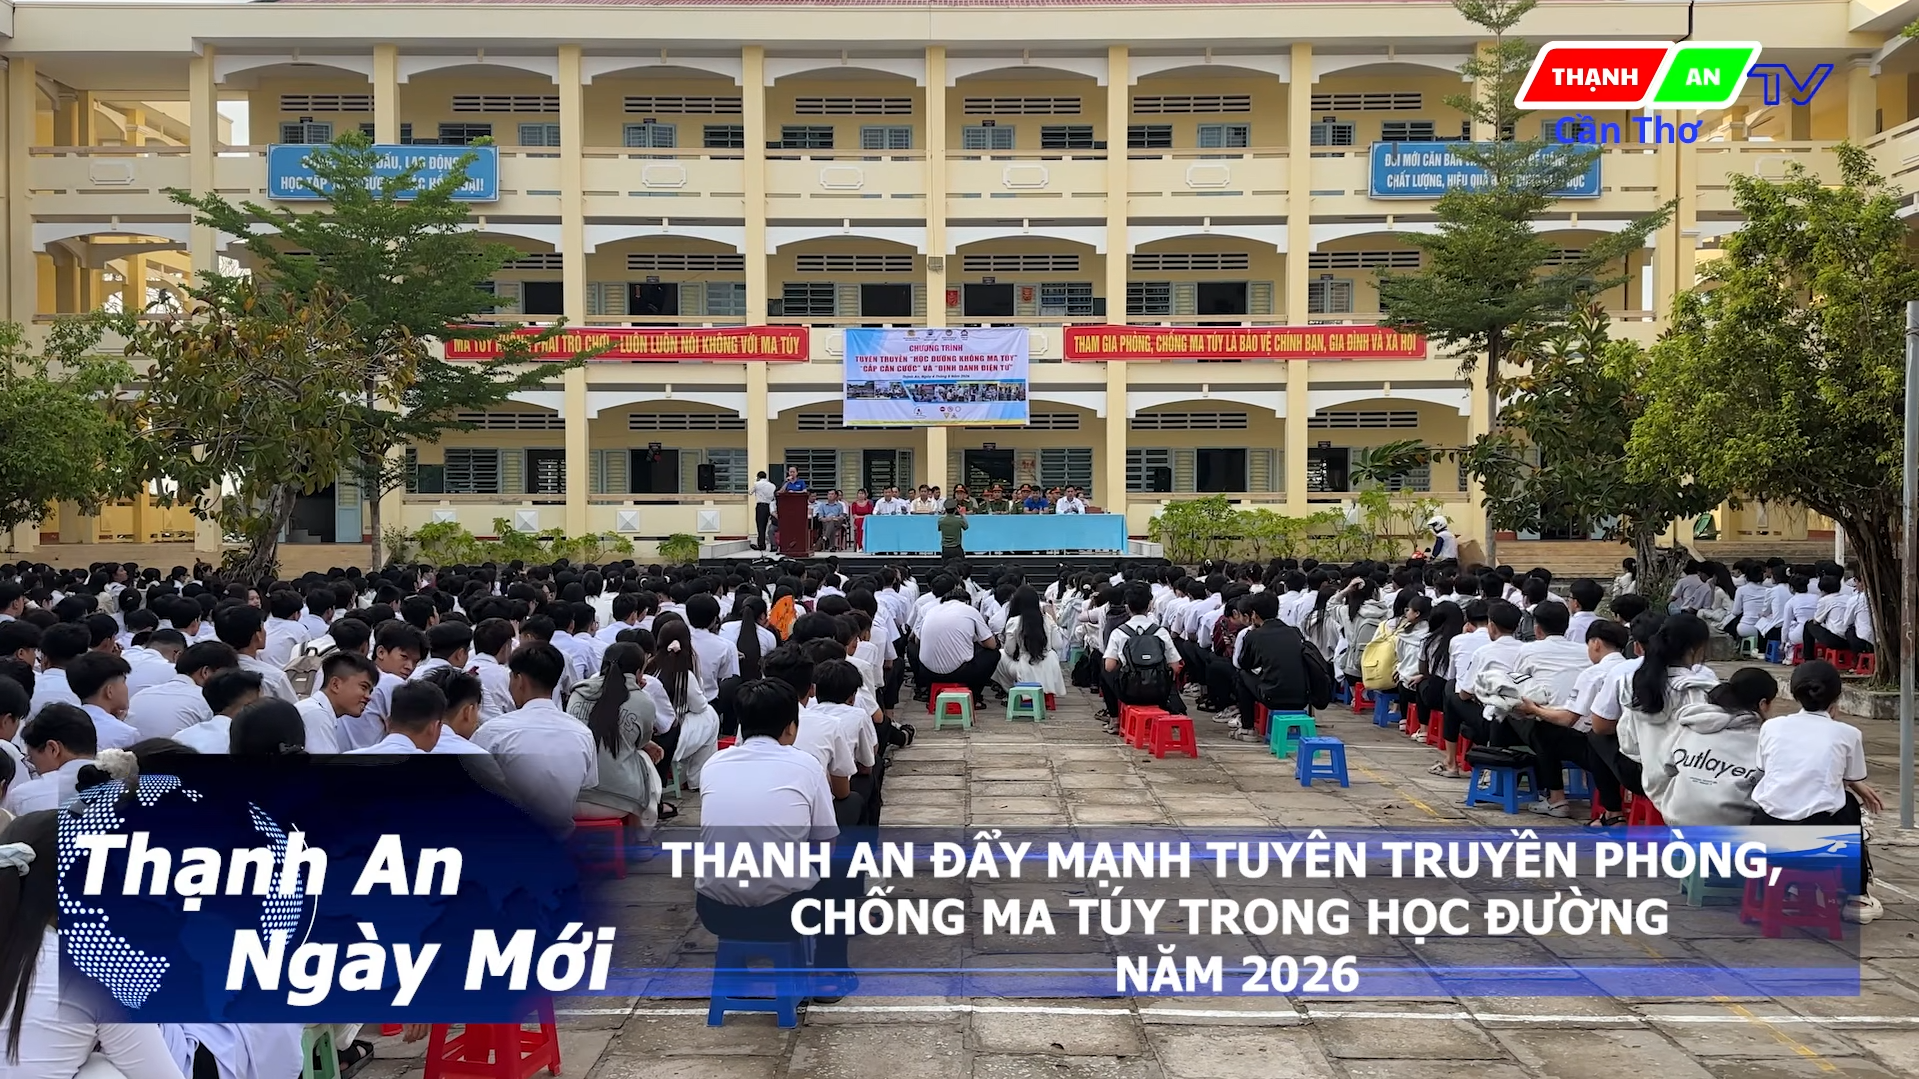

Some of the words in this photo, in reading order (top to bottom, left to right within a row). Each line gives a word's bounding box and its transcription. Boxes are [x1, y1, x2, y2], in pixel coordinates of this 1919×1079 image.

[1403, 151, 1420, 167] MỚI
[1423, 151, 1440, 167] CĂN
[1387, 170, 1410, 188] CHẤT
[1412, 173, 1445, 190] LƯỢNG,
[620, 331, 647, 353] LUÔN
[650, 331, 678, 354] LUÔN
[681, 331, 699, 354] NÓI
[702, 332, 738, 354] KHÔNG
[740, 332, 758, 354] VỚI
[761, 335, 778, 354] MA
[781, 332, 800, 354] TÚY
[909, 344, 939, 352] CHƯƠNG
[942, 343, 963, 352] TRÌNH
[1074, 335, 1100, 353] THAM
[1102, 335, 1118, 353] GIA
[1119, 331, 1154, 354] PHÒNG,
[1156, 329, 1187, 353] CHỐNG
[1189, 334, 1204, 353] MA
[1207, 331, 1224, 353] TÚY
[1225, 331, 1237, 352] LÀ
[1239, 329, 1258, 352] BẢO
[1260, 331, 1271, 355] VỆ
[1274, 330, 1302, 352] CHÍNH
[1305, 333, 1327, 355] BẠN,
[1329, 333, 1345, 352] GIA
[1346, 330, 1370, 352] ĐÌNH
[1371, 330, 1384, 352] VÀ
[1673, 748, 1757, 778] Outlayer
